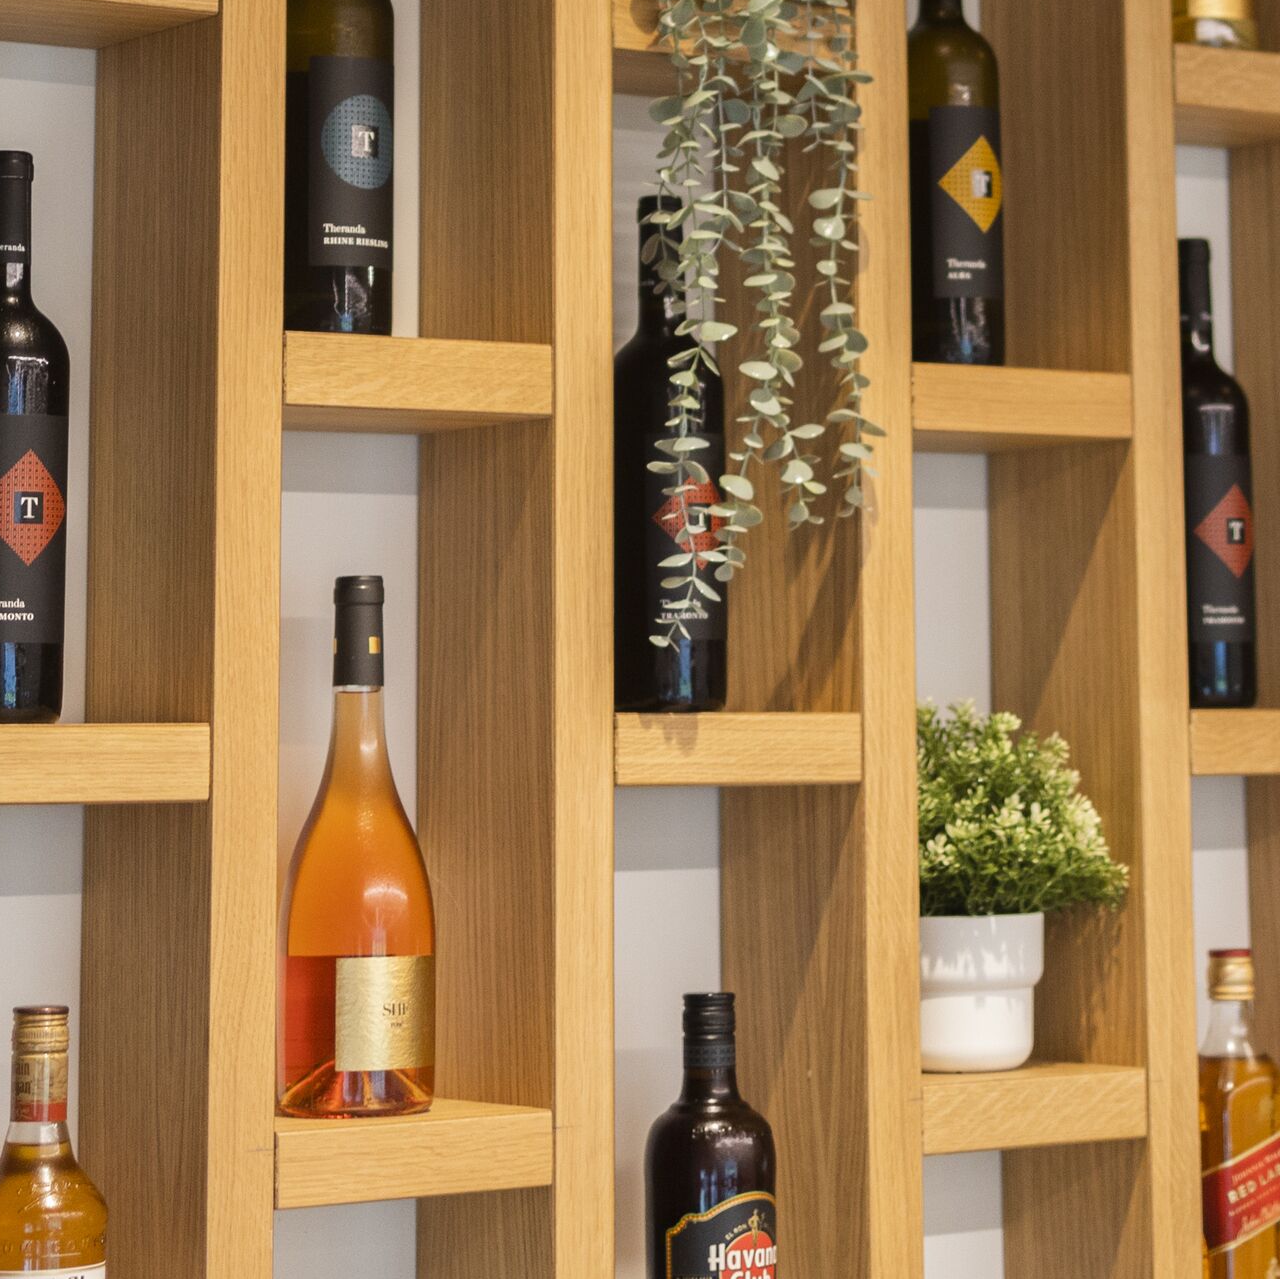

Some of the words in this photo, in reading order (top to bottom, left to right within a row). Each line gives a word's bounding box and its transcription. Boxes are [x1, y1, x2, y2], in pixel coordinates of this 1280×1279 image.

[358, 131, 375, 153] T
[323, 223, 366, 234] Theranda
[323, 236, 354, 246] RHINE
[356, 237, 388, 248] RIESLING
[21, 497, 39, 519] T
[383, 1002, 409, 1017] SHE
[1227, 1180, 1258, 1204] RED
[707, 1242, 777, 1271] Havan
